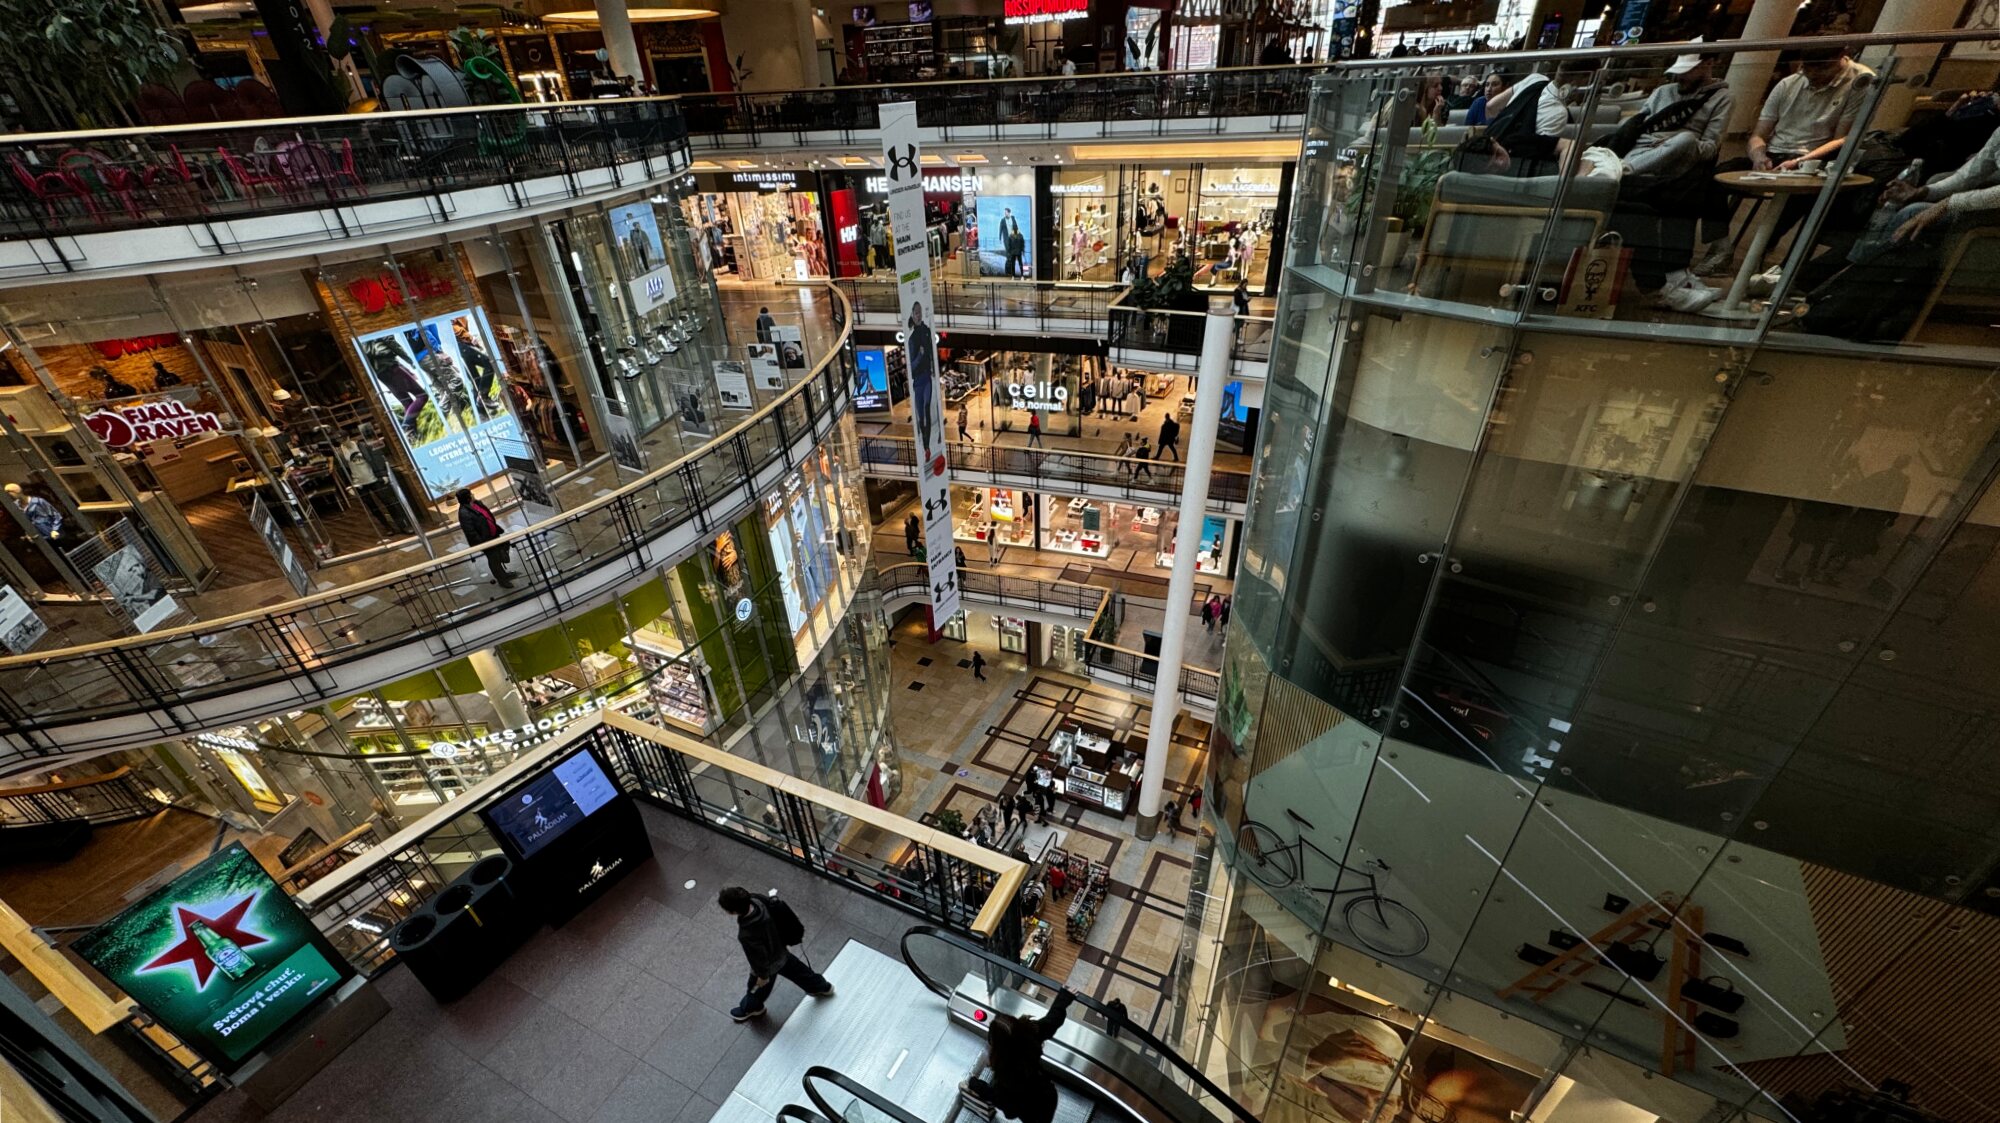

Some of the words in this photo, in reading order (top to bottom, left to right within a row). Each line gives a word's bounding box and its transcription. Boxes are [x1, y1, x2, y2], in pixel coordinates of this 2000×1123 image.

[733, 172, 796, 183] intimissimi
[1050, 185, 1068, 193] KARL
[1068, 185, 1103, 193] LAGERFELD
[896, 234, 911, 245] MAIN
[897, 241, 925, 256] ENTRANCE
[1574, 304, 1598, 312] KFC
[1008, 381, 1068, 400] celio
[1012, 399, 1025, 409] be
[1027, 401, 1064, 411] normal.
[459, 729, 516, 750] YVES
[522, 696, 609, 735] ROCHER
[527, 812, 568, 842] PALLADIUM
[578, 857, 623, 893] PALLADIUM
[212, 990, 265, 1031] Světová
[220, 1006, 259, 1037] Doma
[264, 973, 306, 1002] venku.
